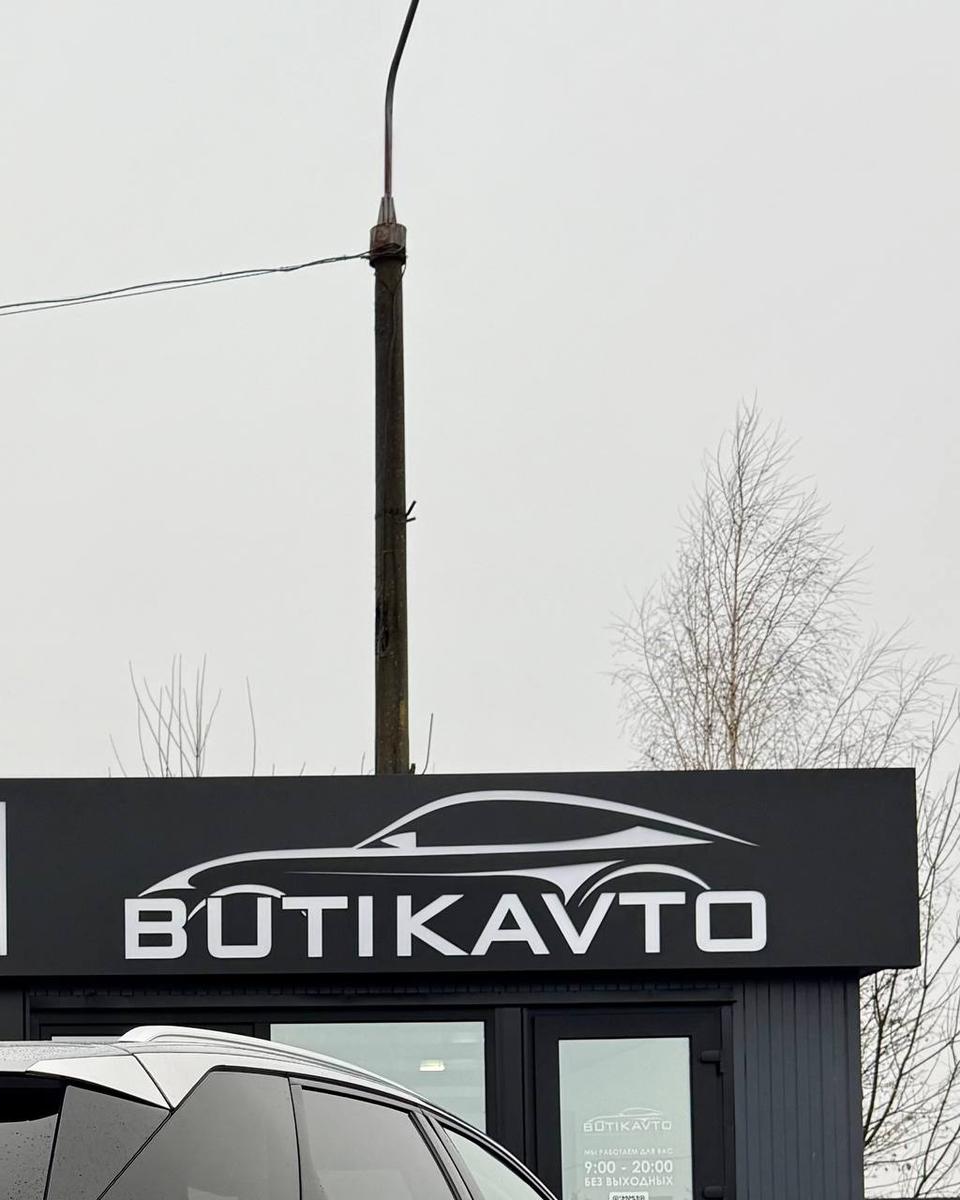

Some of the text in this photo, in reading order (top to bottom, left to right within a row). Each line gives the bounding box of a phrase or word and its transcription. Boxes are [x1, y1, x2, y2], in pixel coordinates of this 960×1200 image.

[124, 890, 767, 960] BUTIKAVTO
[583, 1120, 672, 1132] BUTIKAVTO
[584, 1160, 616, 1174] 9:00
[632, 1160, 673, 1173] 20:00
[584, 1176, 673, 1187] БЕЗ ВЫХОДНЫХ
